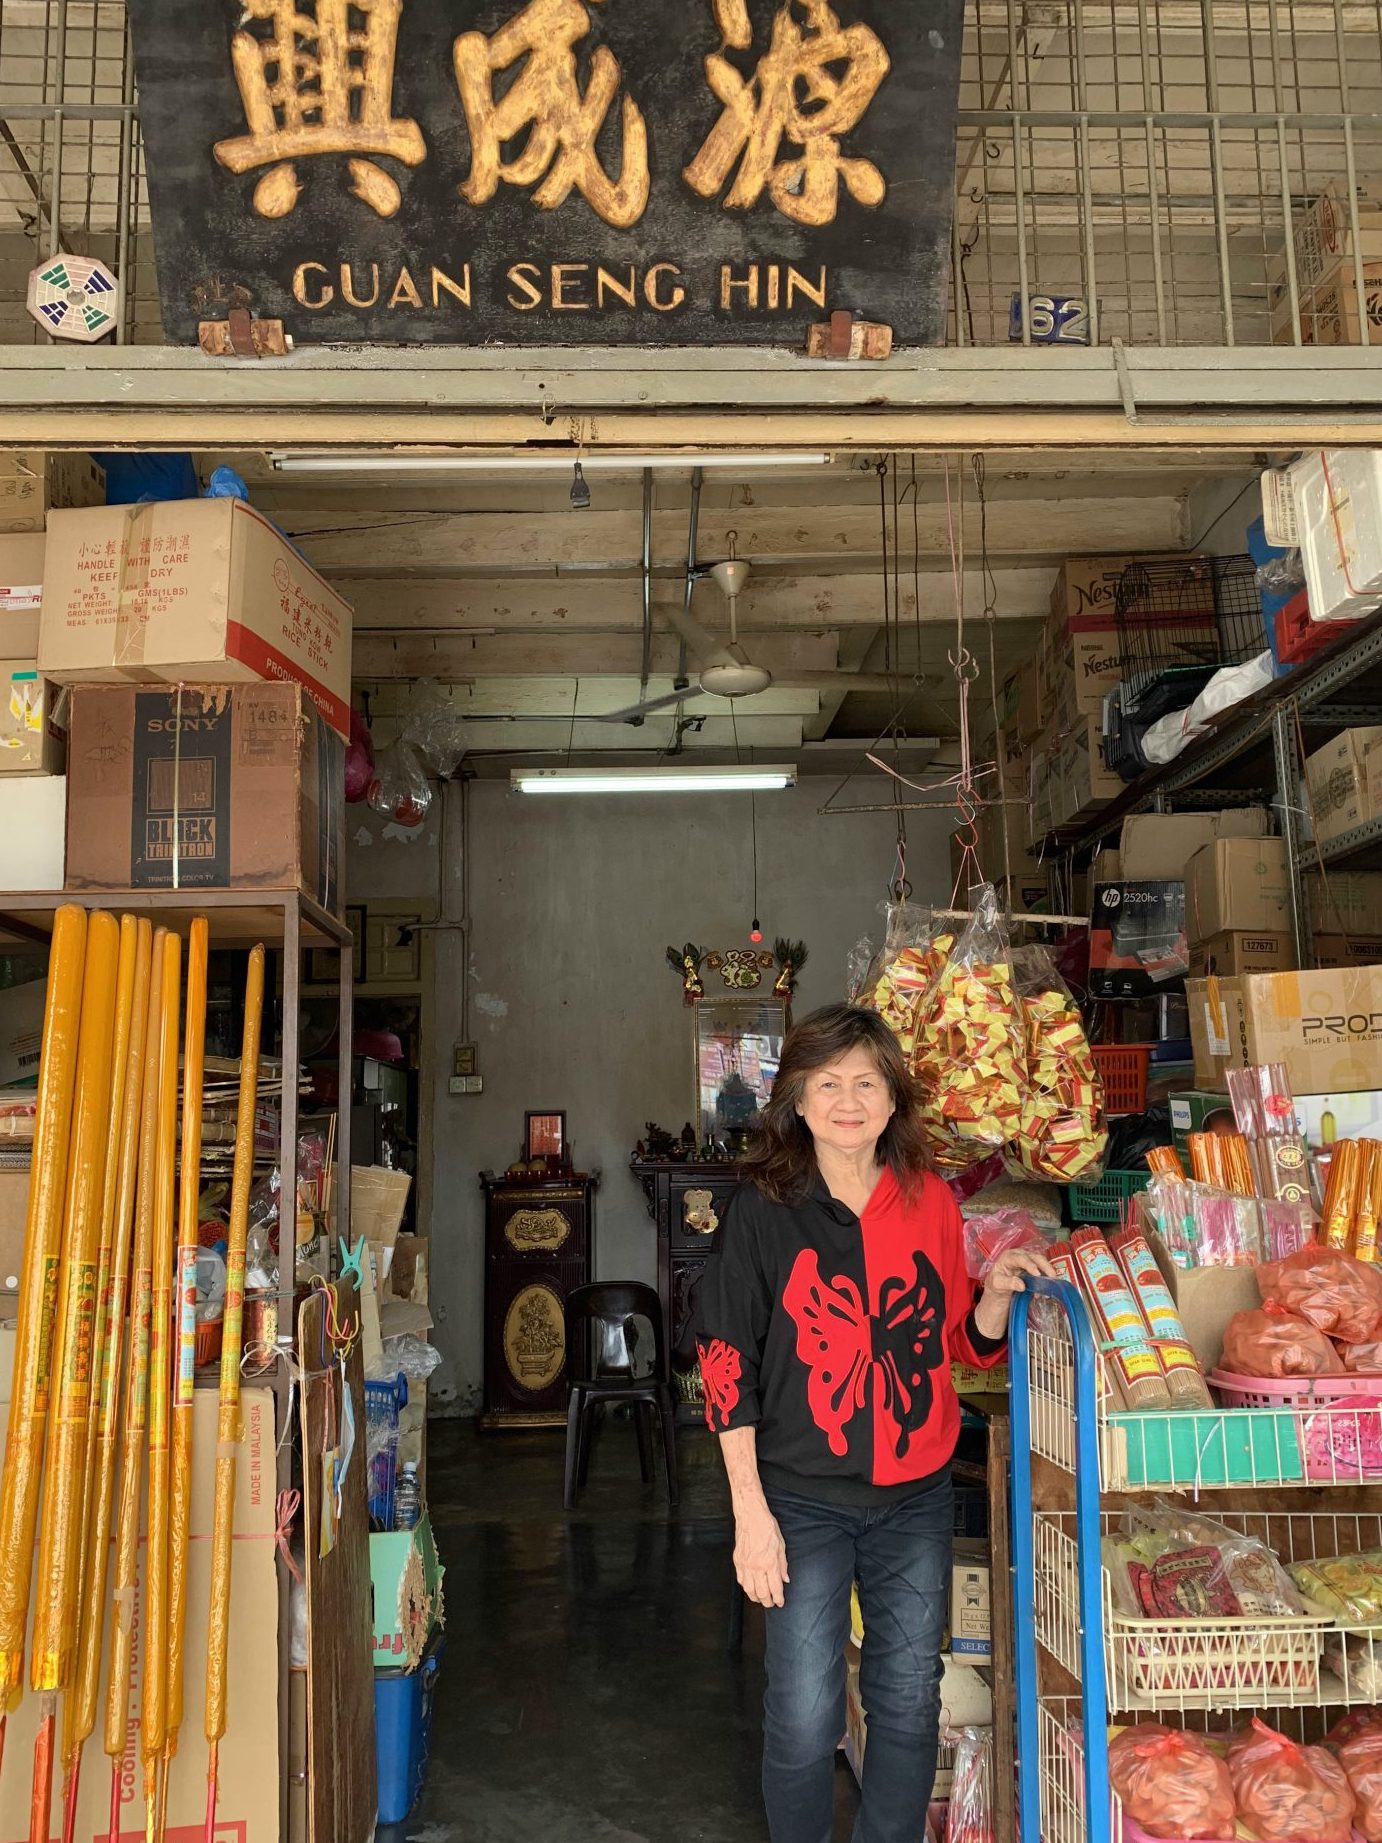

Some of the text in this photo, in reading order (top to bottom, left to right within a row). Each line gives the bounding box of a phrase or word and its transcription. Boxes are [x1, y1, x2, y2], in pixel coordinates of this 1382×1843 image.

[293, 261, 827, 312] GUAN SENG HIN
[1030, 297, 1089, 341] 62
[77, 553, 189, 570] HANDLE WITH CARE
[150, 568, 173, 578] DRY
[82, 592, 106, 601] PKTS
[68, 601, 81, 609] NET
[84, 600, 112, 608] WEIGHT
[67, 609, 92, 618] GROSS
[94, 608, 120, 616] WEIGH
[282, 624, 329, 671] RICE STICK
[313, 692, 334, 717] CHINA
[147, 718, 218, 732] SONY
[148, 842, 213, 858] TRINTRON
[1105, 889, 1159, 908] hp 2520hc
[1246, 941, 1273, 951] 127673
[1304, 1036, 1331, 1045] SIMPLE
[1336, 1035, 1351, 1043] BUT
[250, 1404, 262, 1505] MADE IN MALAYSIA
[966, 1622, 977, 1630] Net
[960, 1641, 991, 1652] SELEC
